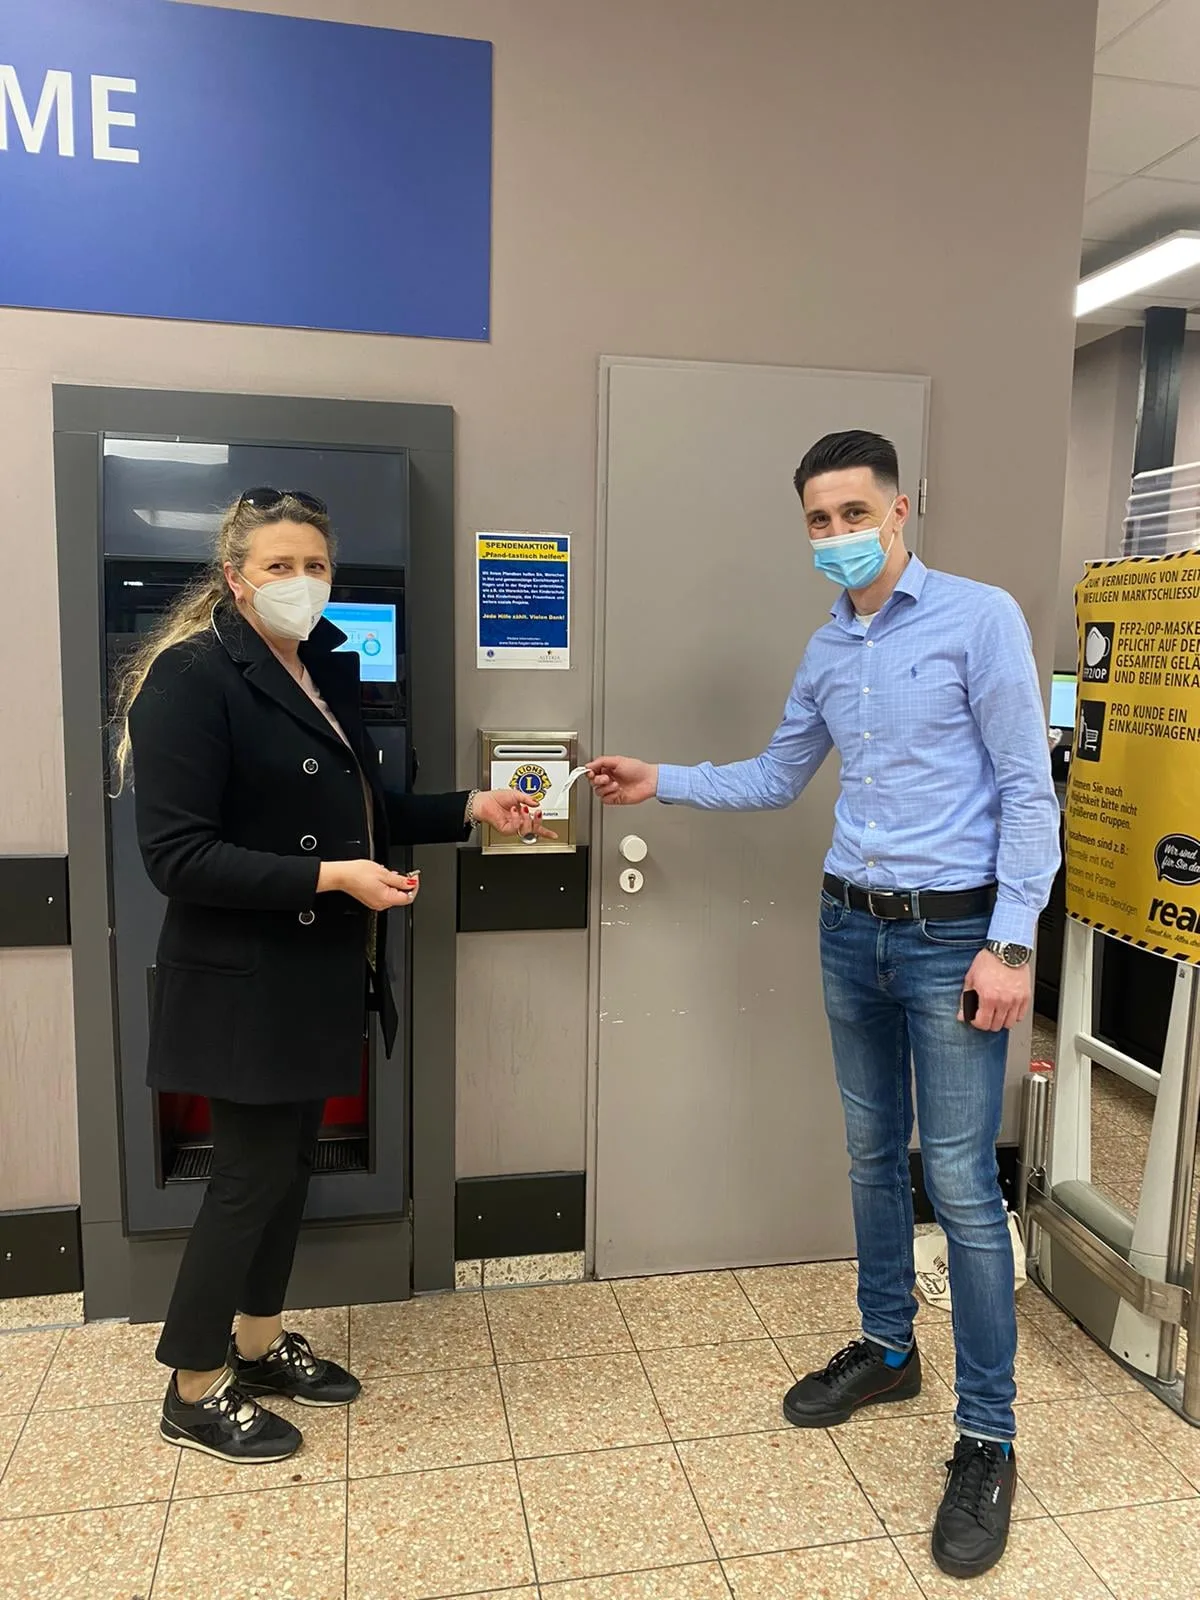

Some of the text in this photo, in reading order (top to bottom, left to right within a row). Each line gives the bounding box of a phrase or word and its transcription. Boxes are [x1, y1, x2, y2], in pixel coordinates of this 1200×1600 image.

[0, 64, 140, 163] ME
[485, 542, 554, 550] SPENDENAKTION
[1085, 576, 1100, 589] ZUR
[1102, 572, 1156, 588] VERMEIDUNG
[1160, 570, 1178, 583] VON
[1084, 590, 1118, 604] WEILIGEN
[1118, 638, 1156, 652] PFLICHT
[1158, 639, 1177, 652] AUF
[1116, 654, 1168, 670] GESAMTEN
[1114, 669, 1136, 684] UND
[1139, 671, 1162, 686] BEIM
[1110, 702, 1188, 724] PRO KUNDE EIN
[518, 764, 543, 775] LIONS
[526, 776, 536, 791] L
[1092, 781, 1104, 794] Sie
[1105, 786, 1123, 798] nach
[1101, 798, 1120, 812] bitte
[1120, 804, 1138, 817] nicht
[1100, 812, 1132, 830] Gruppen.
[1096, 837, 1112, 851] sind
[1164, 844, 1198, 860] Wir sind
[1161, 856, 1174, 870] für
[1175, 858, 1188, 870] Sie
